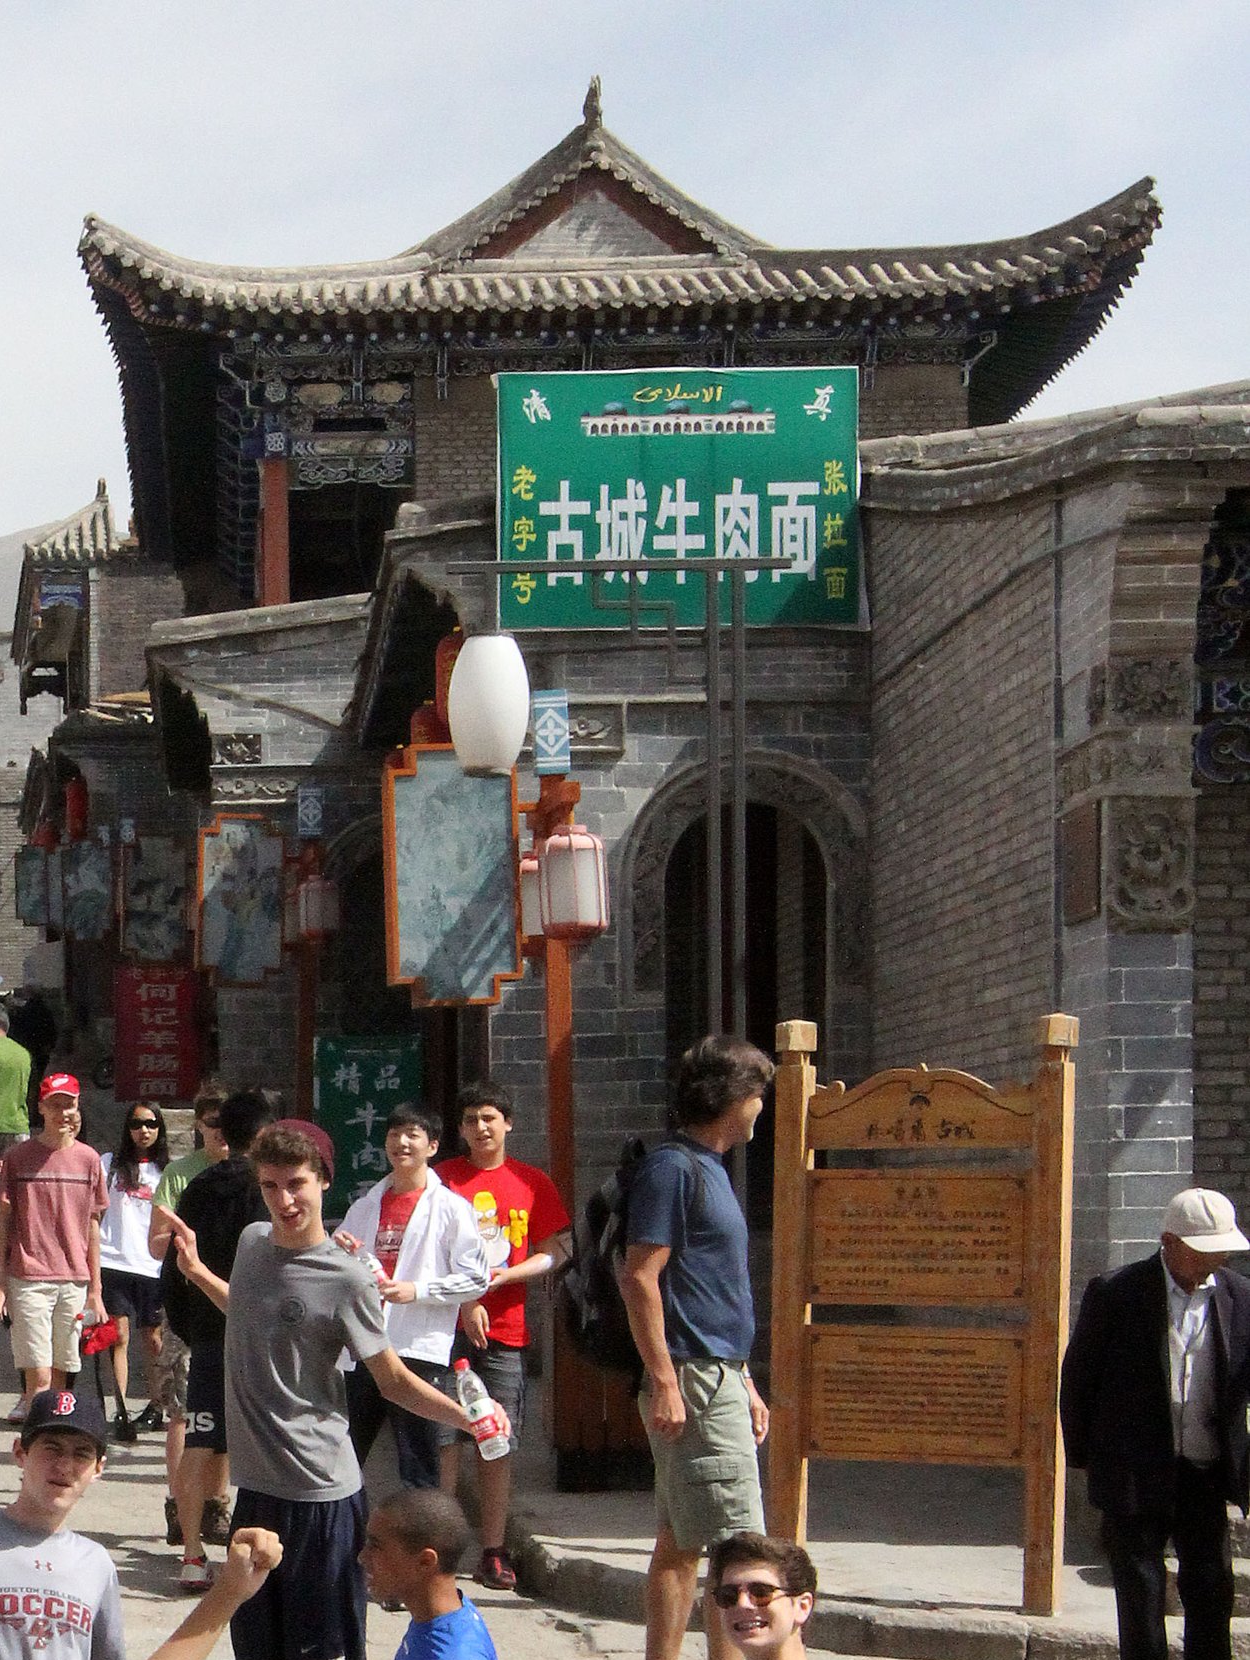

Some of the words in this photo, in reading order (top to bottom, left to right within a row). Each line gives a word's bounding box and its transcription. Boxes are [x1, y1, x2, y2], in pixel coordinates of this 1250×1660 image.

[522, 388, 551, 424] 清
[803, 384, 835, 422] 真
[512, 464, 537, 604] 老字号
[539, 477, 820, 585] 古城牛肉面
[823, 460, 848, 599] 张拉面
[330, 1062, 400, 1095] 精品
[53, 1391, 77, 1416] B
